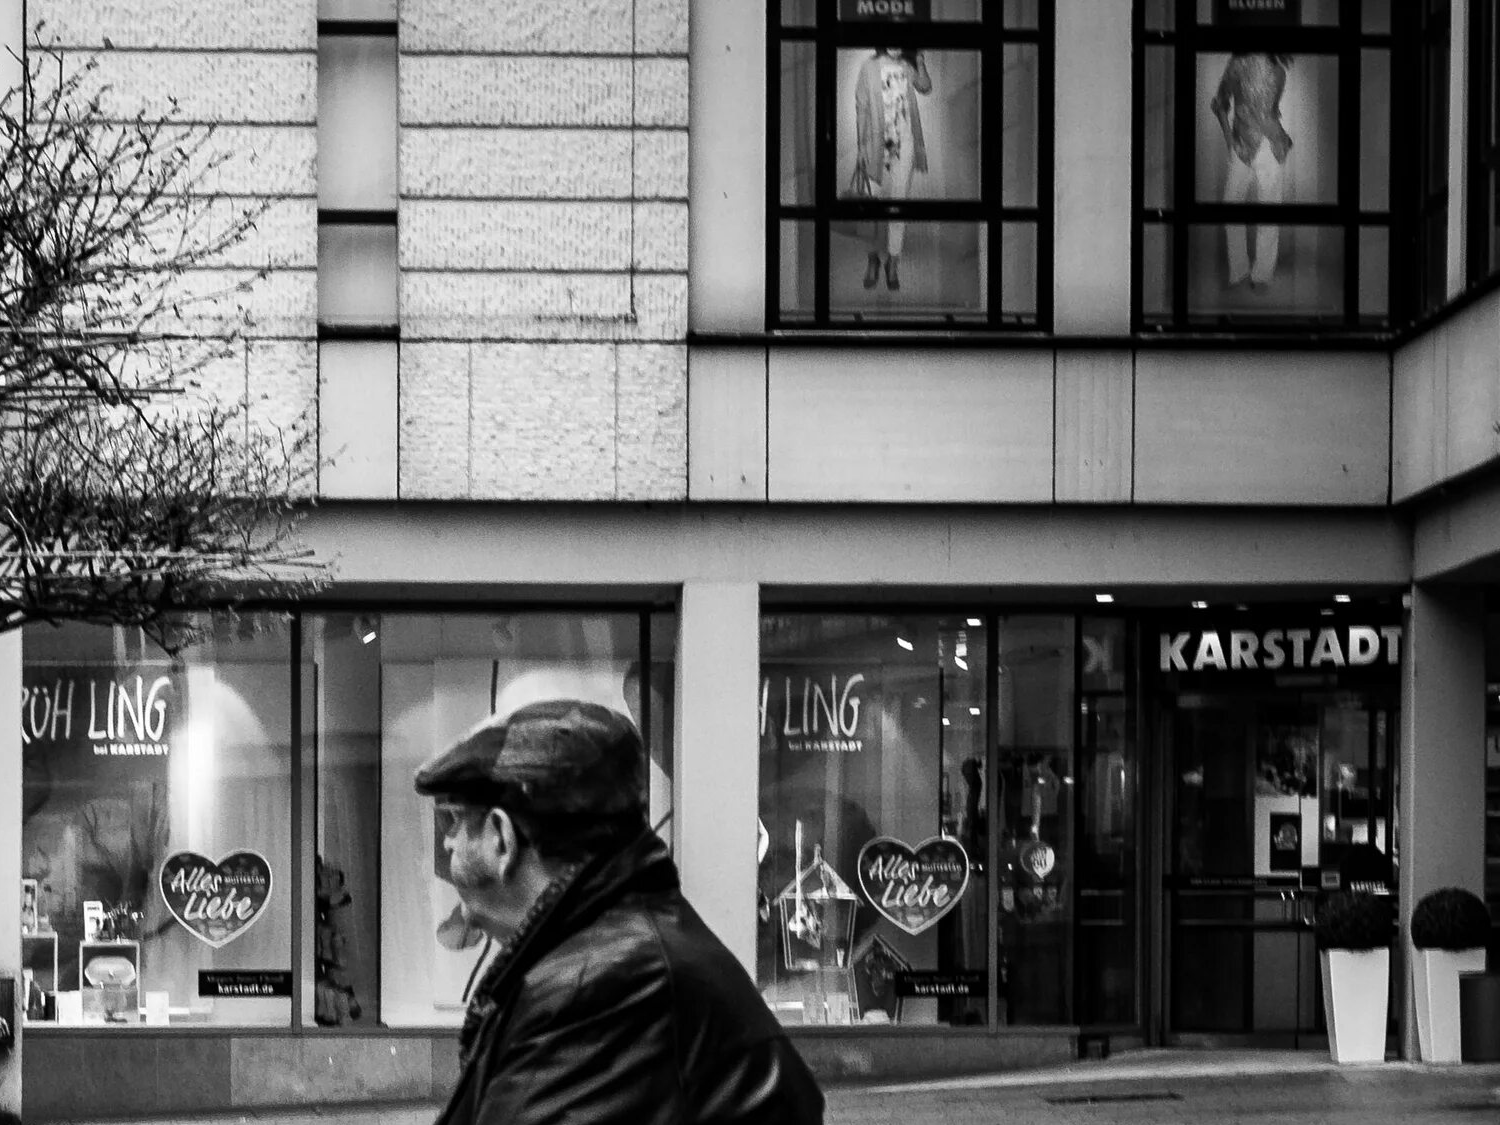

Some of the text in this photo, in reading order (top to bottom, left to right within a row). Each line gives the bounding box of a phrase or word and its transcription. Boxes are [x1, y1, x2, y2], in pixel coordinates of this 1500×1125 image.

[1159, 626, 1402, 671] KARSTADT
[88, 674, 171, 742] LING
[183, 888, 255, 921] Liebe
[881, 874, 951, 907] Liebe
